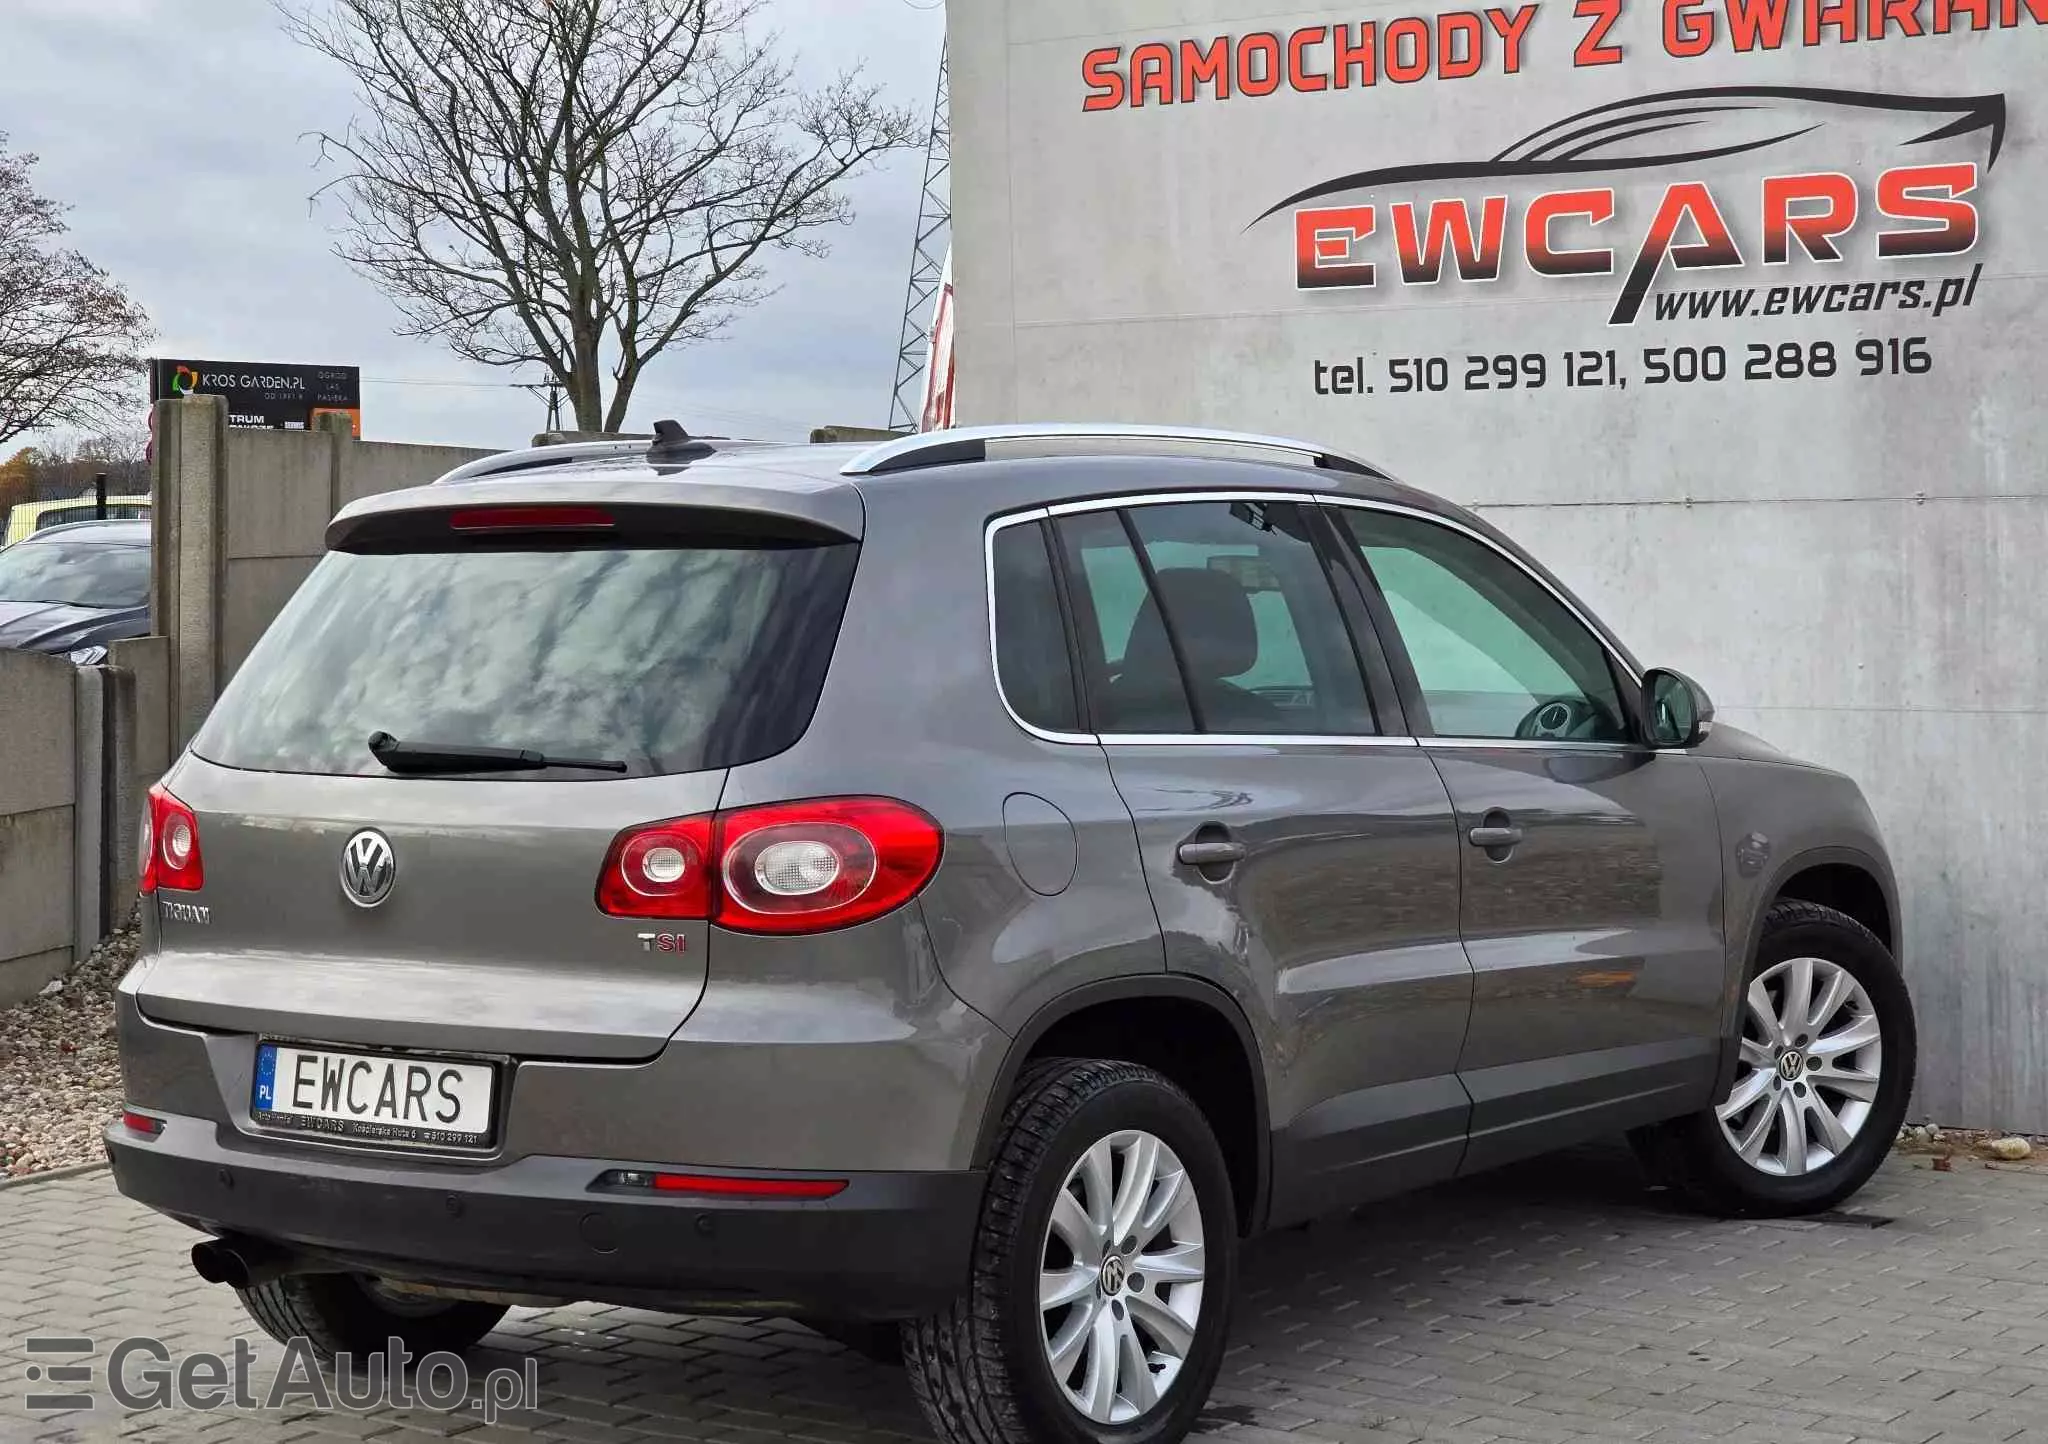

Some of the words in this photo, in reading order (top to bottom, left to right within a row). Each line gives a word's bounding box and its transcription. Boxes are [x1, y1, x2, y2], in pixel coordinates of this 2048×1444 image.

[1082, 3, 1539, 111] SAMOCHODY
[1573, 0, 1623, 68] Z
[1295, 162, 1978, 327] EWCARS
[1655, 263, 1983, 320] www.ewcars.pl
[202, 374, 236, 388] KROS
[240, 375, 305, 390] GARDEN.PL
[1314, 356, 1374, 395] tel.
[1389, 357, 1448, 393] 510
[1465, 353, 1546, 390] 299
[1563, 350, 1626, 389] 121,
[1643, 345, 1726, 384] 500
[1745, 341, 1837, 380] 288
[1855, 336, 1932, 376] 916
[637, 933, 685, 953] TSI
[259, 1084, 272, 1101] PL
[291, 1054, 464, 1124] EWCARS
